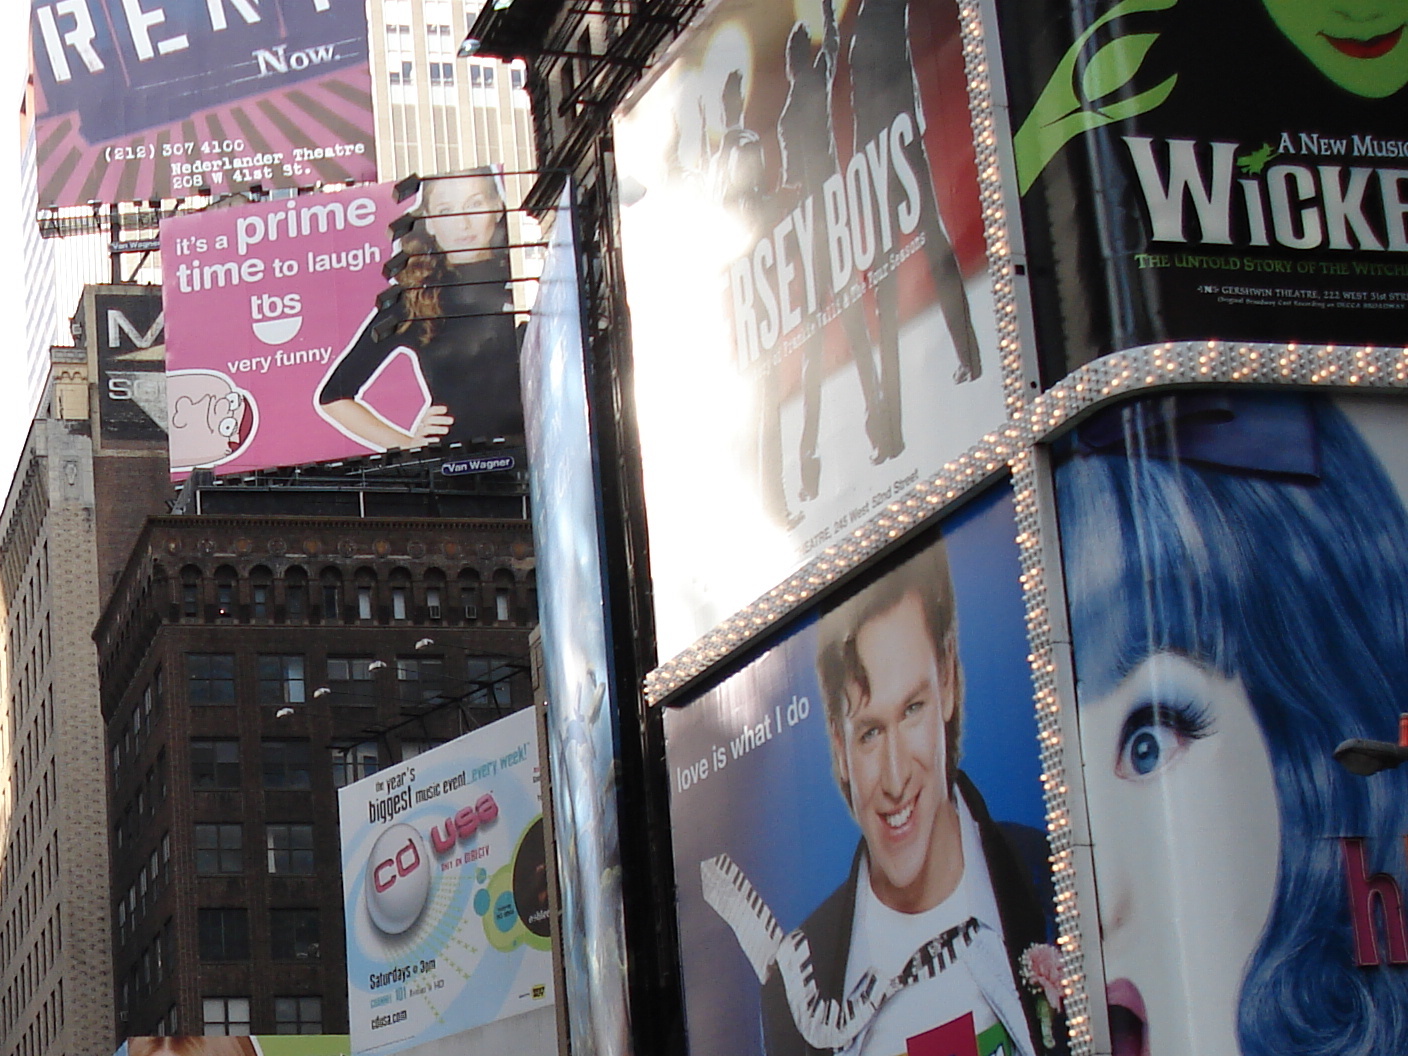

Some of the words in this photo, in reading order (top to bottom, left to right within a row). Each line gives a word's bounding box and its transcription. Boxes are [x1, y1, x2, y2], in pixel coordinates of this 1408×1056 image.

[252, 43, 341, 77] Now.
[104, 143, 156, 163] (212)
[162, 142, 194, 156] 307
[200, 139, 245, 153] 4100
[1278, 132, 1296, 154] A
[171, 153, 284, 176] Nederlander
[293, 142, 366, 161] Theatre
[172, 174, 203, 189] 208
[212, 170, 224, 184] W
[232, 166, 273, 182] 41st
[823, 112, 922, 294] BOYS
[176, 236, 208, 256] it's
[215, 235, 229, 249] a
[236, 197, 377, 256] prime
[176, 258, 265, 293] time
[273, 259, 299, 278] to
[308, 243, 381, 272] laugh
[730, 195, 818, 364] RSEY
[1134, 254, 1170, 269] THE
[1175, 254, 1240, 270] UNTOLD
[1243, 257, 1292, 274] STORY
[1297, 260, 1317, 274] OF
[1319, 261, 1349, 276] THE
[251, 292, 302, 319] tbs
[1222, 286, 1272, 298] GERSHWIN
[1343, 290, 1368, 301] WEST
[227, 356, 272, 374] very
[275, 346, 333, 367] funny
[446, 463, 468, 473] Van
[469, 458, 510, 470] Wagner
[849, 503, 870, 523] West
[893, 468, 920, 494] Street
[676, 758, 709, 793] love
[712, 745, 727, 772] is
[730, 714, 772, 760] what
[775, 705, 782, 733] I
[787, 695, 810, 726] do
[386, 766, 416, 795] year's
[369, 785, 413, 824] biggest
[415, 782, 441, 804] music
[374, 838, 421, 894] cd
[430, 793, 500, 854] usa
[370, 965, 411, 990] Saturdays
[420, 959, 436, 974] 3pm
[371, 1010, 407, 1030] cdusa.com
